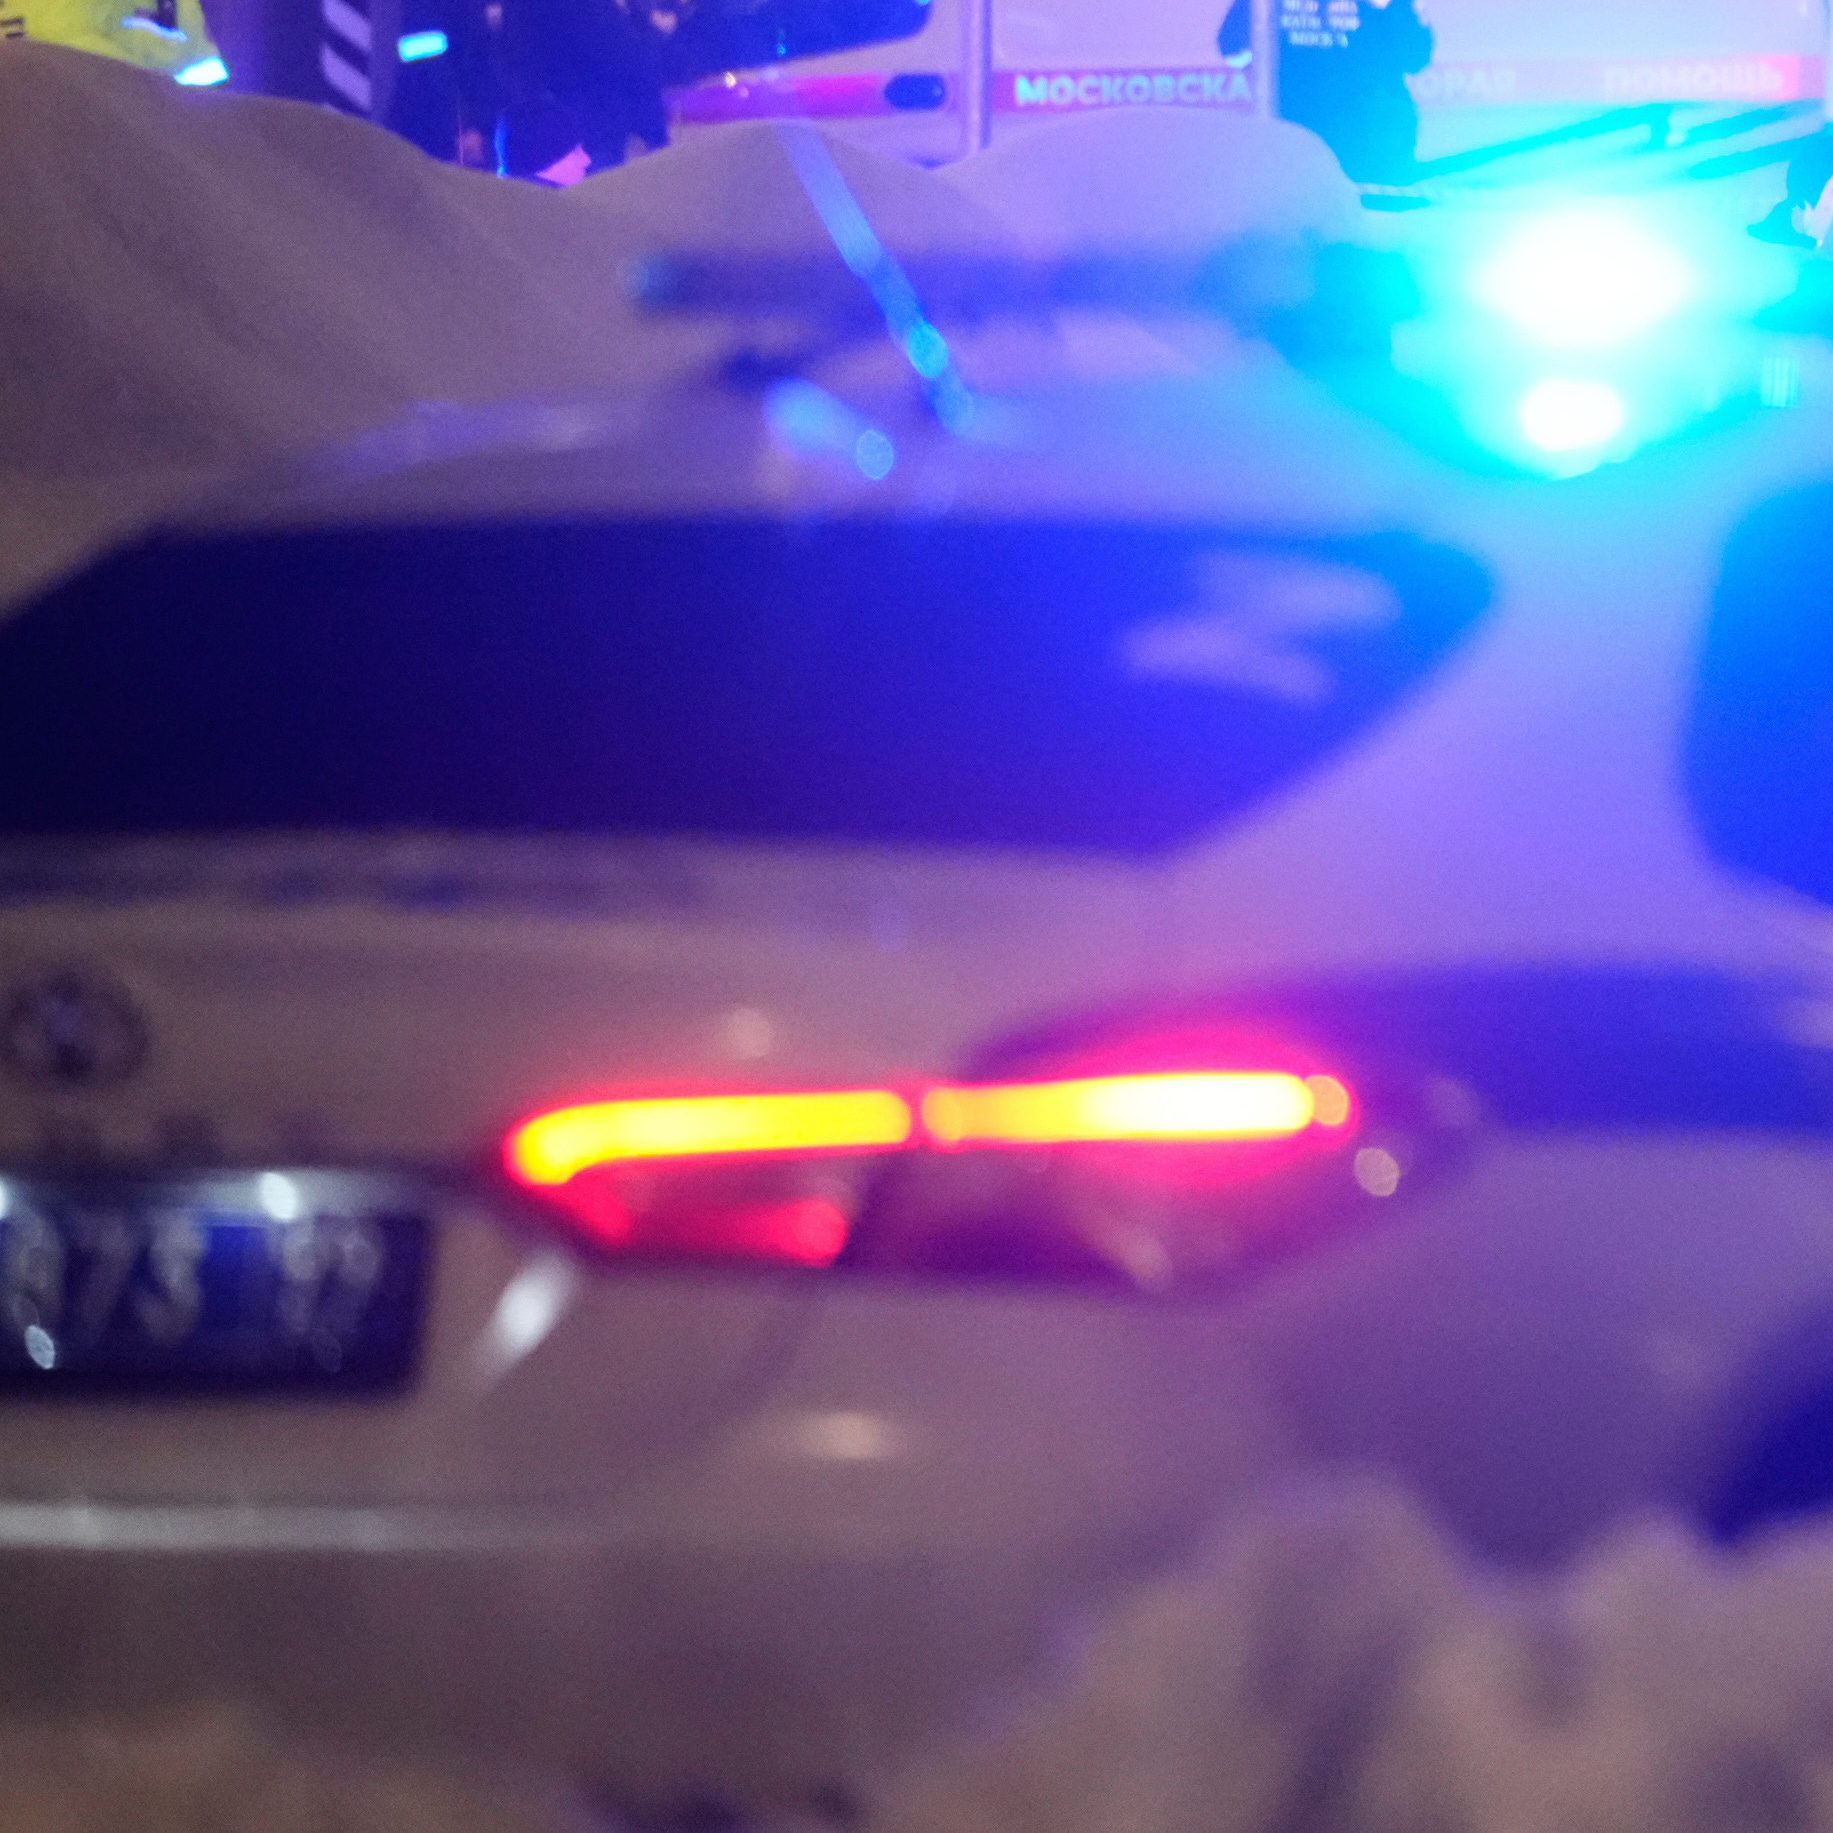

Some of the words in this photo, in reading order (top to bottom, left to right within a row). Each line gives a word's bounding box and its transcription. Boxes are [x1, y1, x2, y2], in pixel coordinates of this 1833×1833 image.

[1014, 75, 1253, 105] МОСКОВСКА
[1404, 69, 1517, 101] ОРАЯ
[1604, 62, 1784, 100] ПОМОЩЬ
